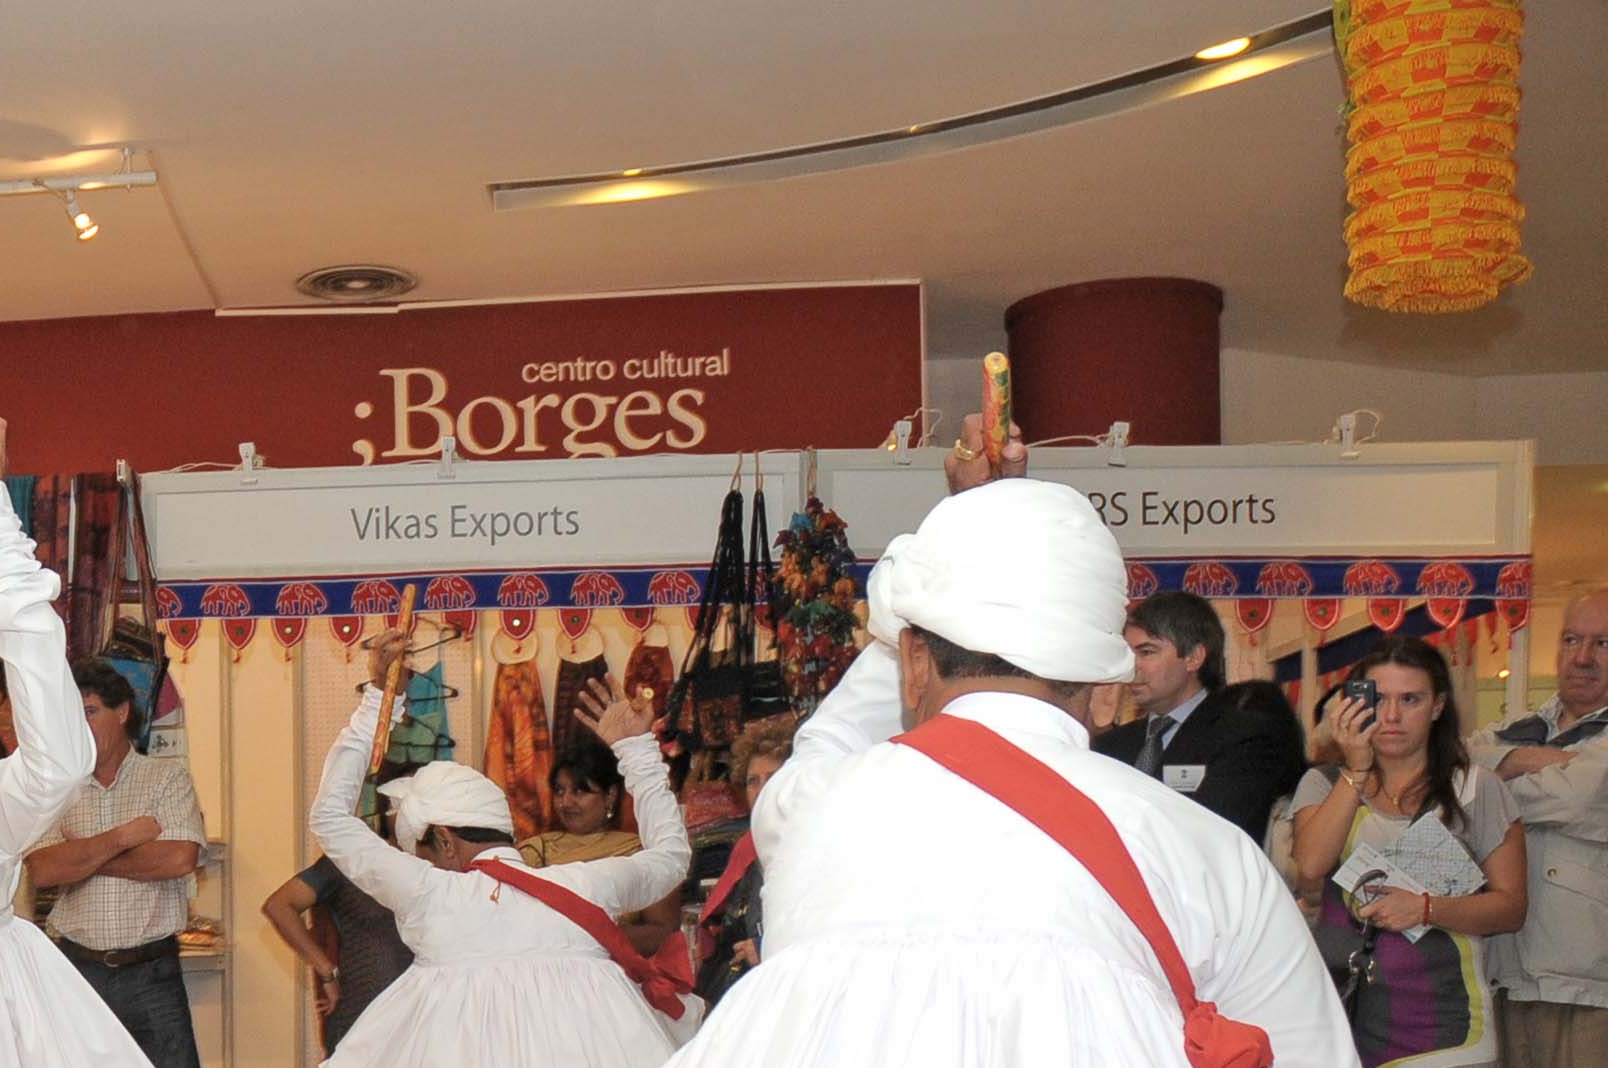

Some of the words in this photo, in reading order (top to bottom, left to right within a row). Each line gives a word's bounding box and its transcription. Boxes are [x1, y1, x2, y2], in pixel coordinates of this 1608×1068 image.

[521, 356, 615, 384] centro
[623, 348, 730, 380] cultural
[350, 505, 439, 540] Vikas
[450, 504, 580, 546] Exports
[1141, 491, 1276, 535] Exports
